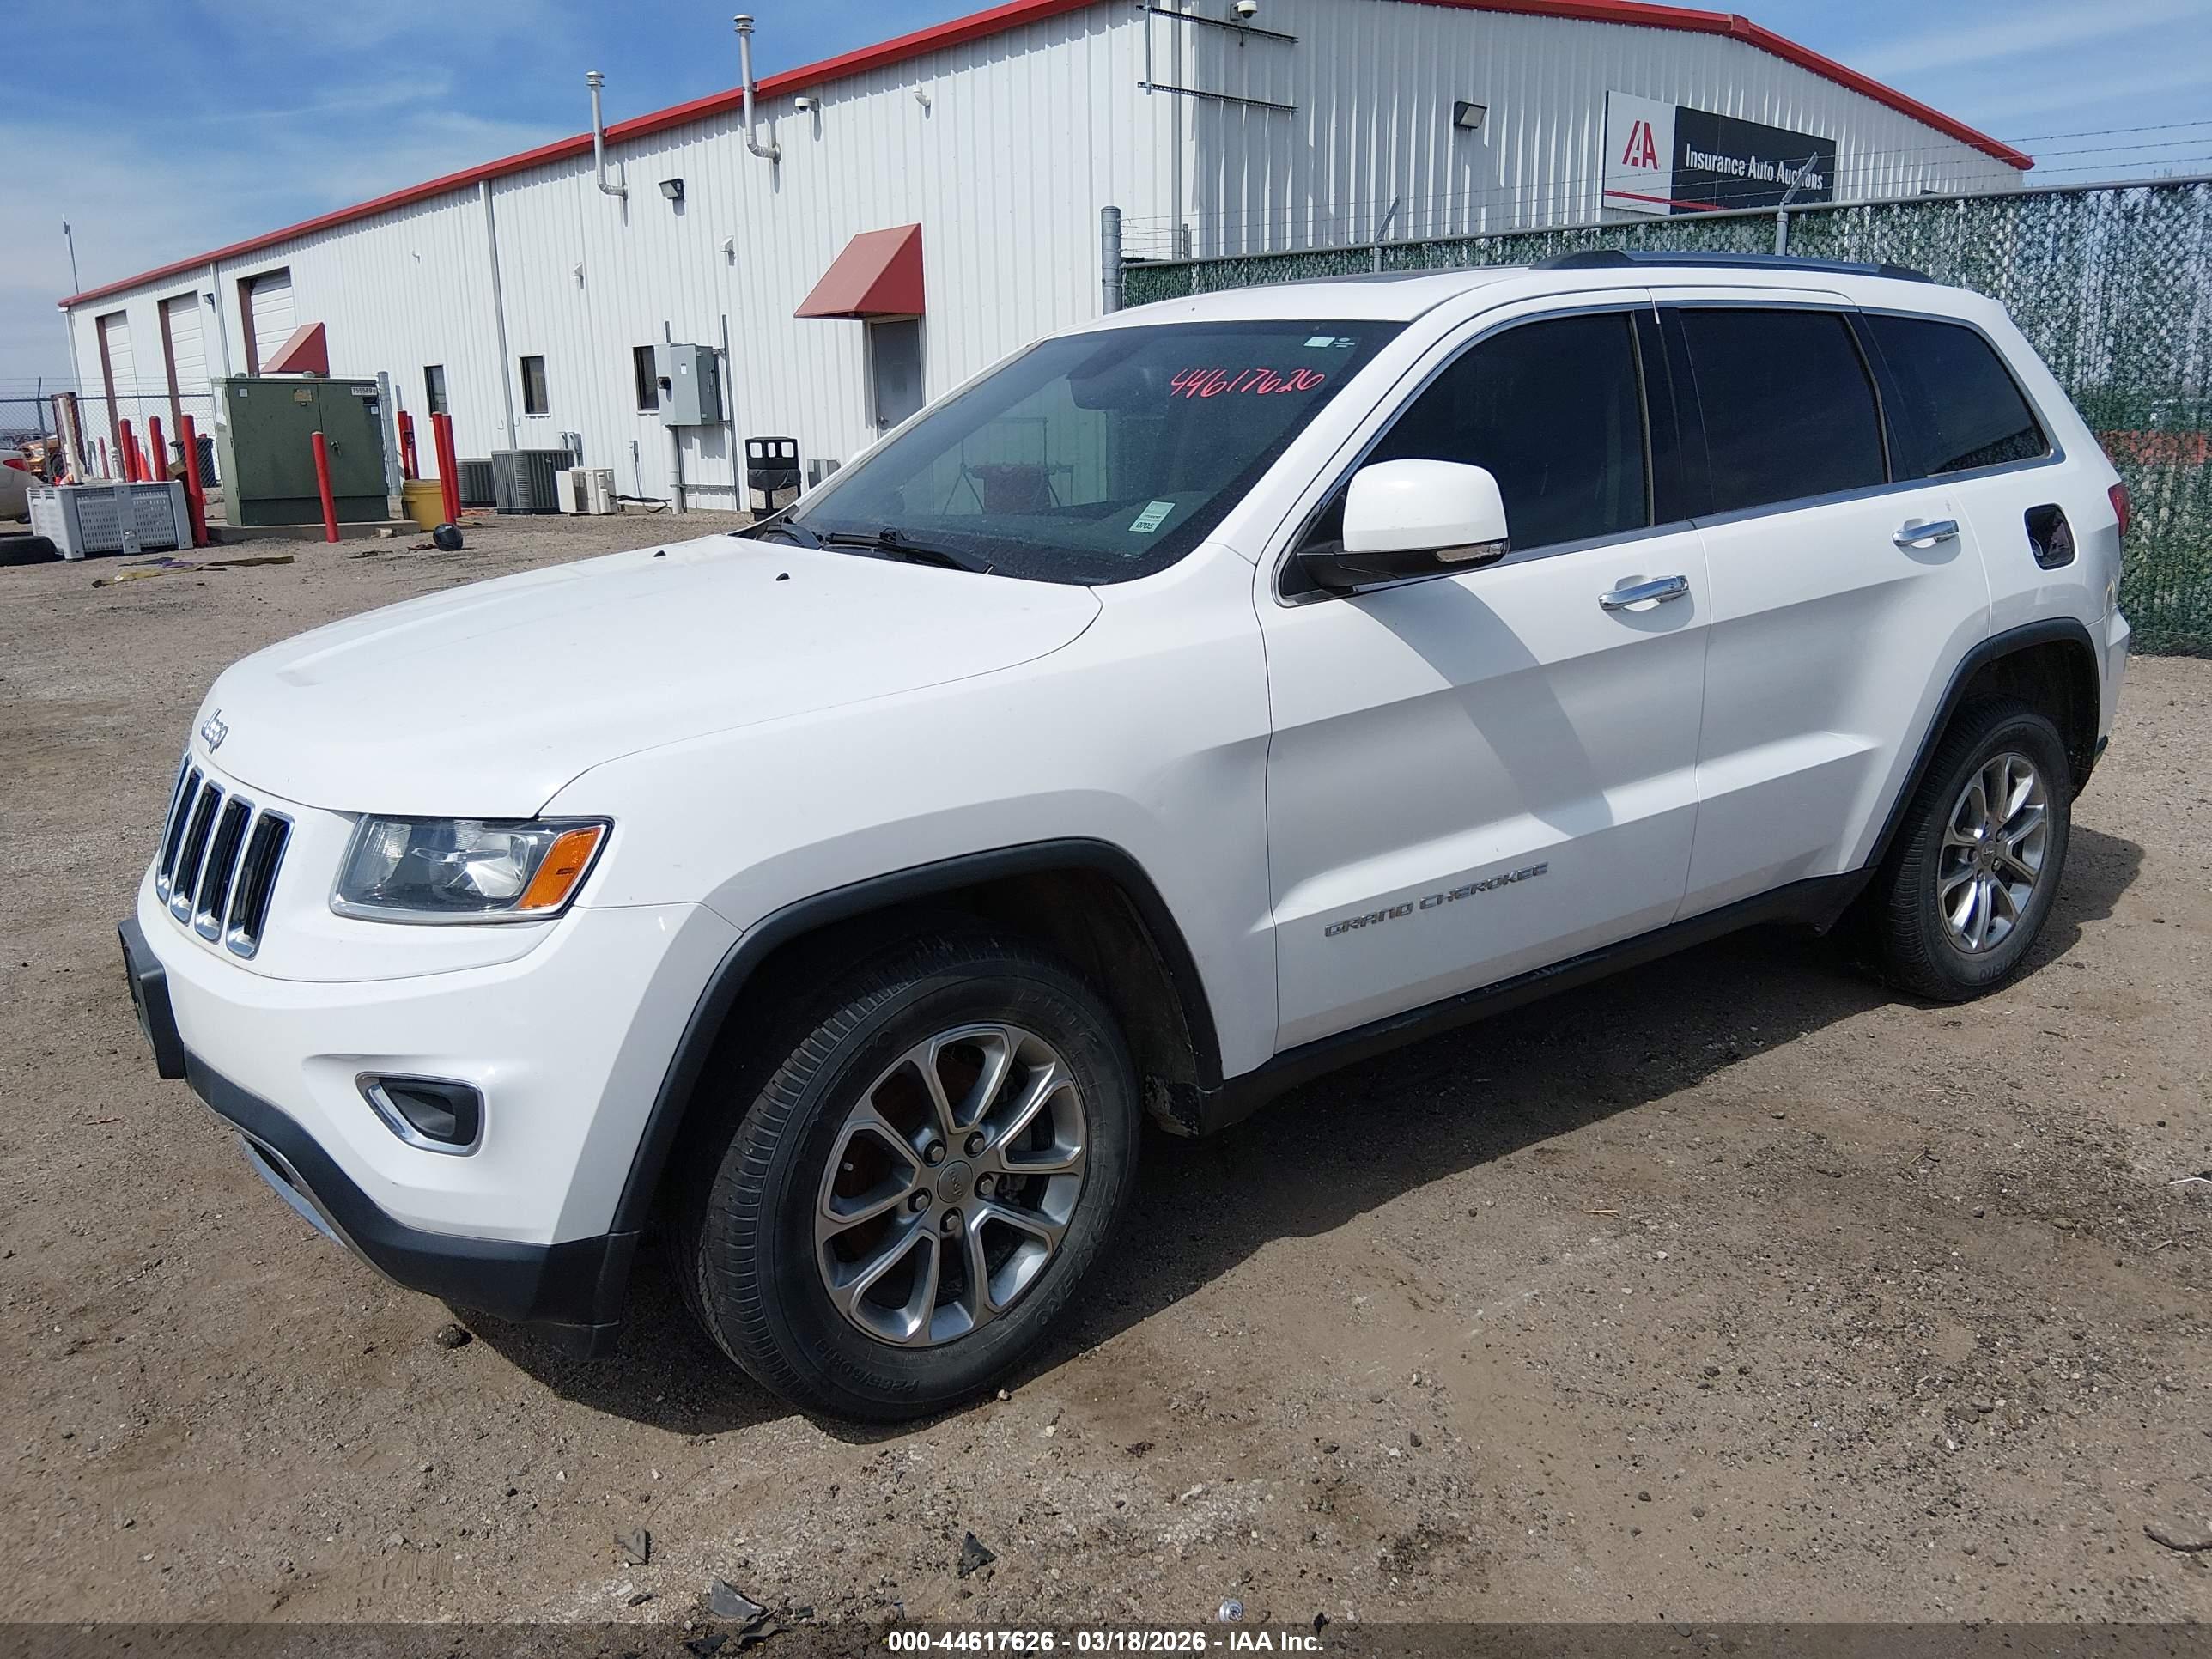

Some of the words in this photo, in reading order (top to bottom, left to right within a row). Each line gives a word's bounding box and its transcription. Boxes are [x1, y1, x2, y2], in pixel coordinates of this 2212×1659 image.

[1686, 143, 1746, 177] Insurance
[1748, 155, 1774, 181] Auto
[1170, 368, 1325, 398] 44617626
[1325, 900, 1414, 937] GRAND
[1419, 861, 1548, 910] CHEROKEE
